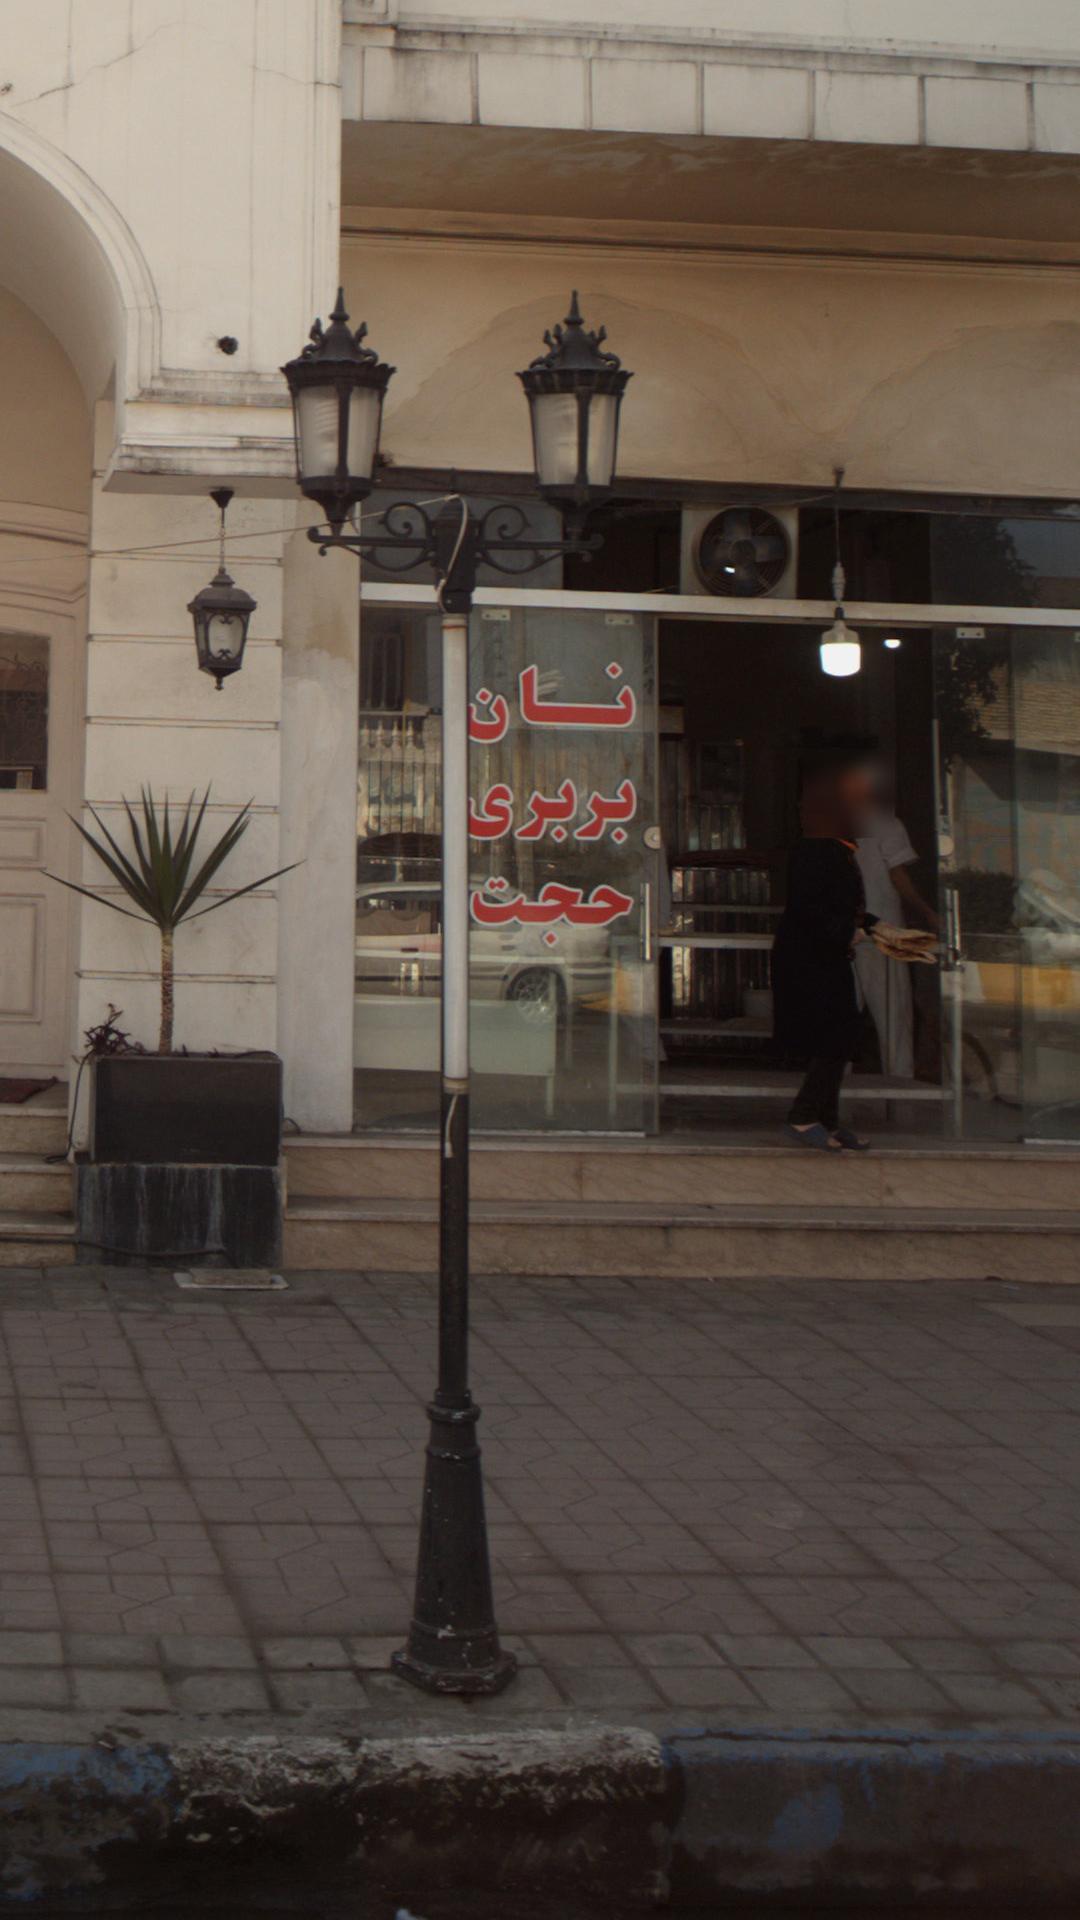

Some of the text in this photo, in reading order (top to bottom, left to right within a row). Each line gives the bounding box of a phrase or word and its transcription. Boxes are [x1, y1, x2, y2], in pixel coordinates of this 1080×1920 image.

[469, 661, 636, 743] نان
[469, 778, 637, 845] بربری
[470, 876, 634, 947] حجت
